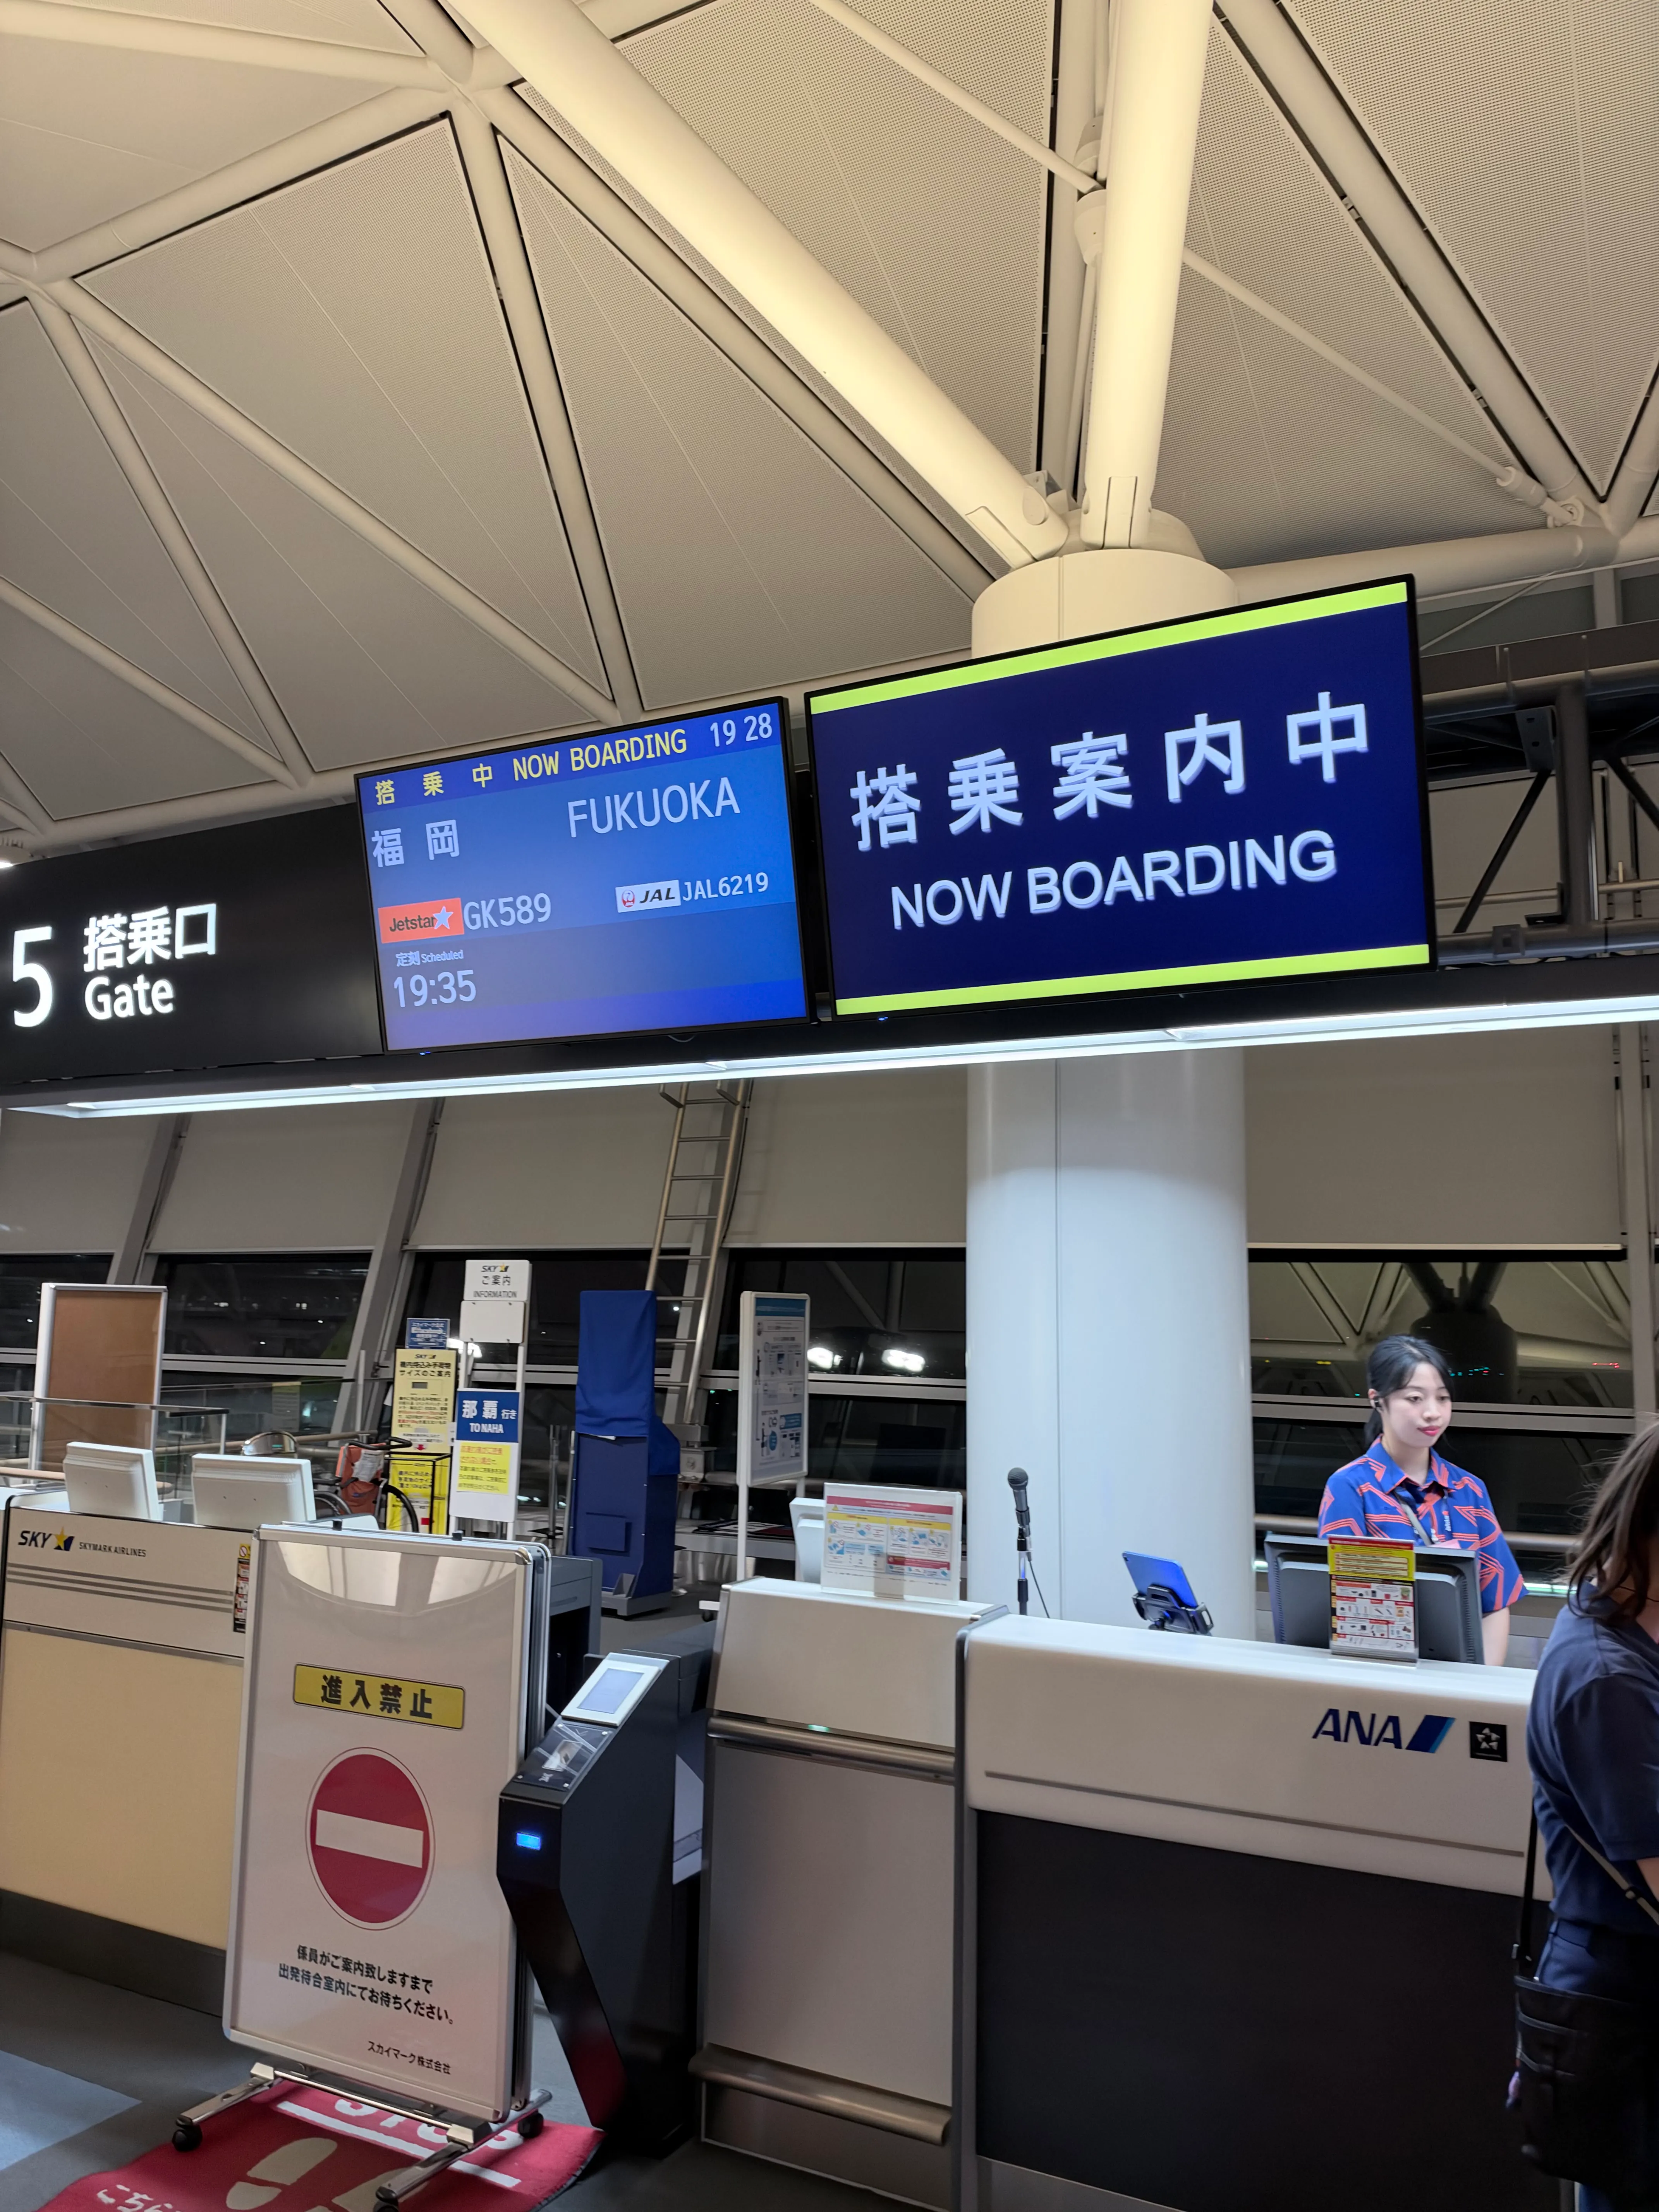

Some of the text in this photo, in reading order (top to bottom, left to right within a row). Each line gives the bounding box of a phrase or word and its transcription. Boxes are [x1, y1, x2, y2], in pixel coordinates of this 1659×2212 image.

[513, 729, 688, 781] NOW BOARDING
[850, 691, 1369, 852] 搭乗案内中
[568, 777, 740, 838] FUKUOKA
[371, 819, 460, 867] 福岡
[639, 872, 769, 903] JAL JAL6219
[891, 830, 1337, 929] NOW BOARDING
[389, 892, 551, 932] Jetstar GK589
[83, 903, 217, 972] 搭乗口
[421, 950, 464, 963] Scheduled
[13, 926, 53, 1027] 5
[84, 974, 174, 1020] Gate
[393, 969, 476, 1007] 19:35
[483, 1275, 511, 1286] ご案内
[469, 1422, 504, 1433] TO NAHA
[18, 1530, 146, 1557] SKY SKYMARK AIRLINES
[321, 1675, 433, 1719] 進入禁止
[1312, 1708, 1403, 1749] ANA
[297, 1944, 433, 1994] 係員がご案内致しますまで
[278, 1963, 454, 2025] 出発待合室内にてお待ちください。
[368, 2041, 451, 2075] スカイマーク株式会社
